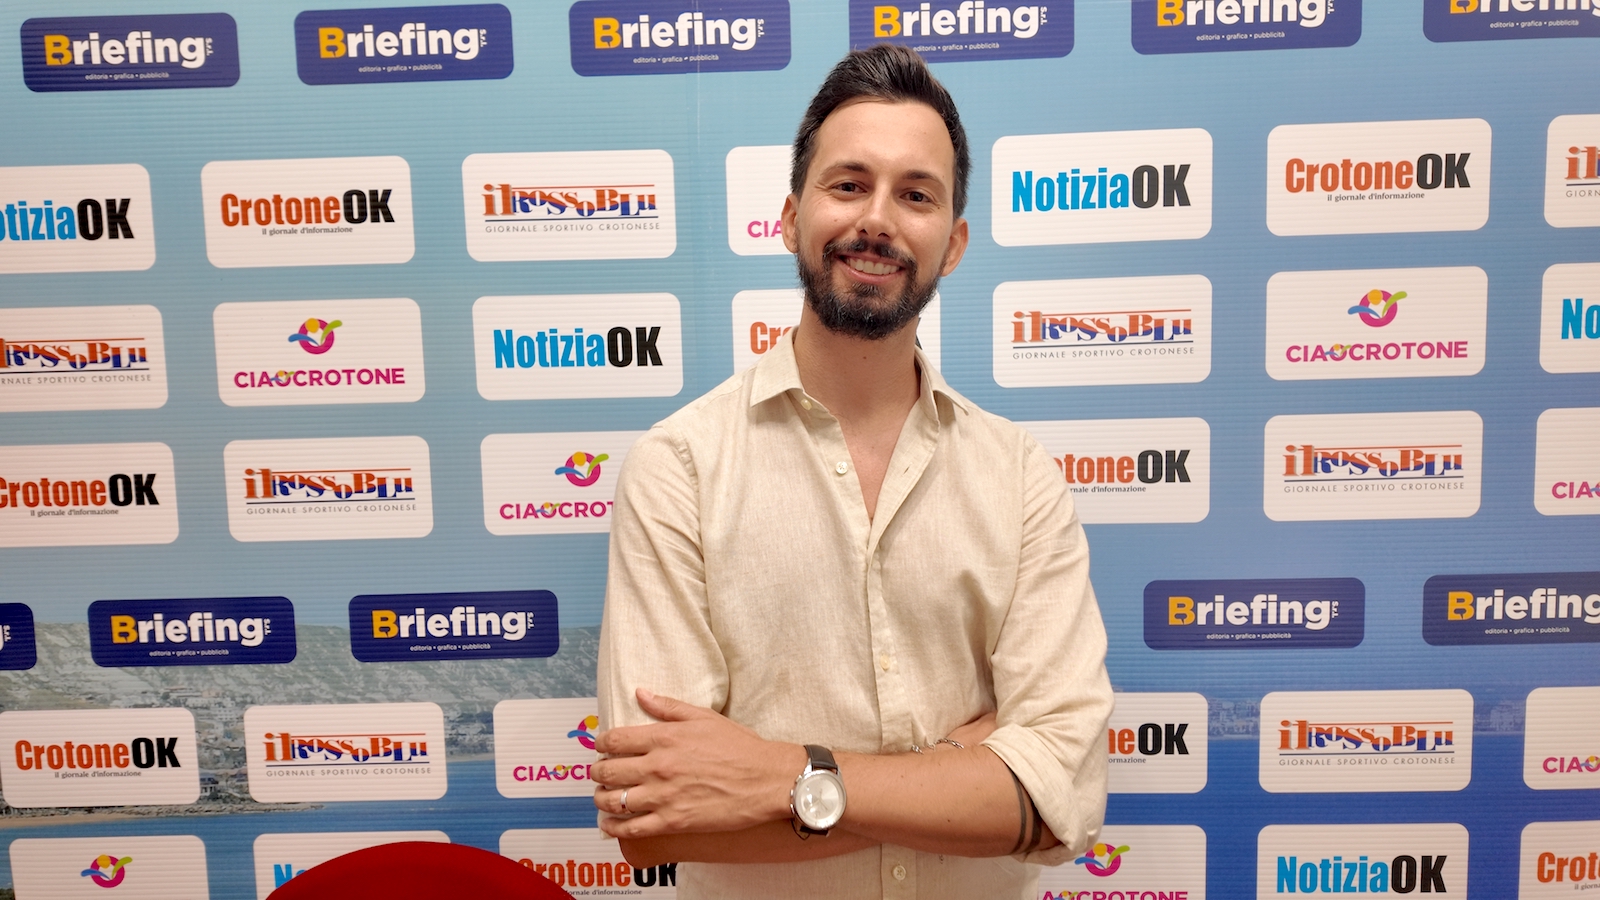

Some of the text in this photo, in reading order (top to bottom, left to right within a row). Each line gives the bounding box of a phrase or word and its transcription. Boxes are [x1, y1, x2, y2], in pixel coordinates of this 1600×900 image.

[874, 0, 1039, 39] Briefing
[1489, 19, 1579, 29] editoria grafica pubblicità
[594, 12, 757, 51] Briefing
[1196, 33, 1221, 41] editoria
[1253, 31, 1286, 39] pubblicità
[318, 23, 479, 61] Briefing
[913, 44, 936, 52] editoria
[969, 42, 1000, 50] pubblicità
[44, 30, 206, 69] Briefing
[689, 54, 719, 62] pubblicità
[413, 63, 442, 71] pubblicità
[1285, 152, 1471, 193] CrotoneOK
[1012, 164, 1191, 213] NotiziaOK
[1334, 193, 1366, 202] giornale
[1368, 192, 1425, 200] d'informazione
[220, 189, 395, 227] CrotoneOK
[269, 227, 298, 236] giornale
[300, 226, 353, 235] d'informazione
[485, 222, 660, 233] GIORNALE SPORTIVO CROTONESE
[750, 321, 793, 355] Cr
[493, 326, 664, 369] NotiziaOK
[1012, 347, 1195, 360] GIORNALE SPORTIVO CROTONESE
[37, 375, 87, 384] SPORTIVO
[91, 374, 151, 383] CROTONESE
[1091, 485, 1147, 493] d'informazione
[1283, 482, 1465, 493] GIORNALE SPORTIVO CROTONESE
[37, 509, 65, 517] giornale
[67, 508, 119, 516] d'informazione
[246, 503, 417, 515] GIORNALE SPORTIVO CROTONESE
[1447, 588, 1600, 624] Briefing
[1168, 594, 1331, 631] Briefing
[110, 611, 264, 647] Briefing
[371, 606, 527, 641] Briefing
[1261, 632, 1291, 640] pubblicità
[1513, 627, 1535, 635] grafica
[1539, 626, 1570, 634] pubblicità
[15, 737, 181, 771] CrotoneOK
[1279, 758, 1331, 766] GIORNALE
[1393, 756, 1456, 765] CROTONESE
[61, 771, 89, 779] giornale
[91, 770, 142, 778] d'informazione
[266, 767, 432, 777] GIORNALE SPORTIVO CROTONESE
[1537, 851, 1600, 884] Crot
[1277, 855, 1448, 894] NotiziaOK
[566, 888, 590, 896] ornale
